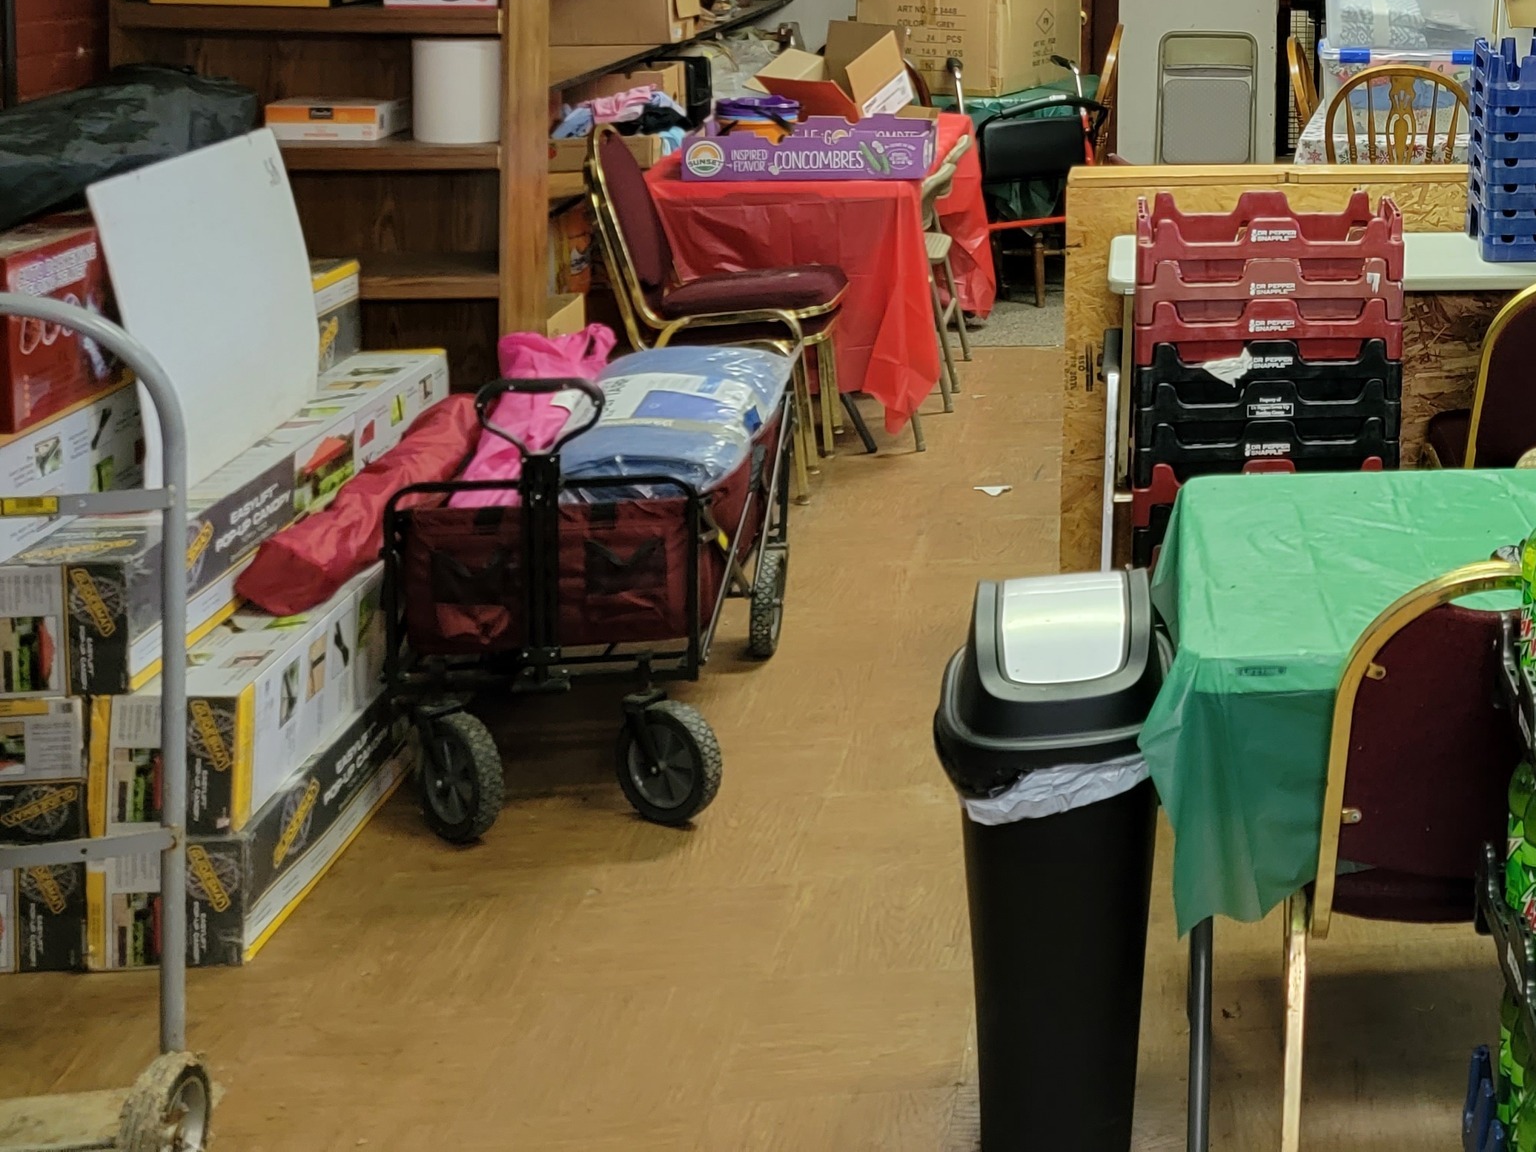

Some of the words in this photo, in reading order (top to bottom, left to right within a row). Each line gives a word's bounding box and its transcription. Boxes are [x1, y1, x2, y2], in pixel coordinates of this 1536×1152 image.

[946, 36, 962, 44] PCS
[946, 48, 964, 57] KGS
[731, 150, 768, 160] INSPIRED
[688, 160, 722, 168] SUNSET
[774, 150, 864, 170] CONCOMBRES
[734, 160, 766, 172] FLAVOR
